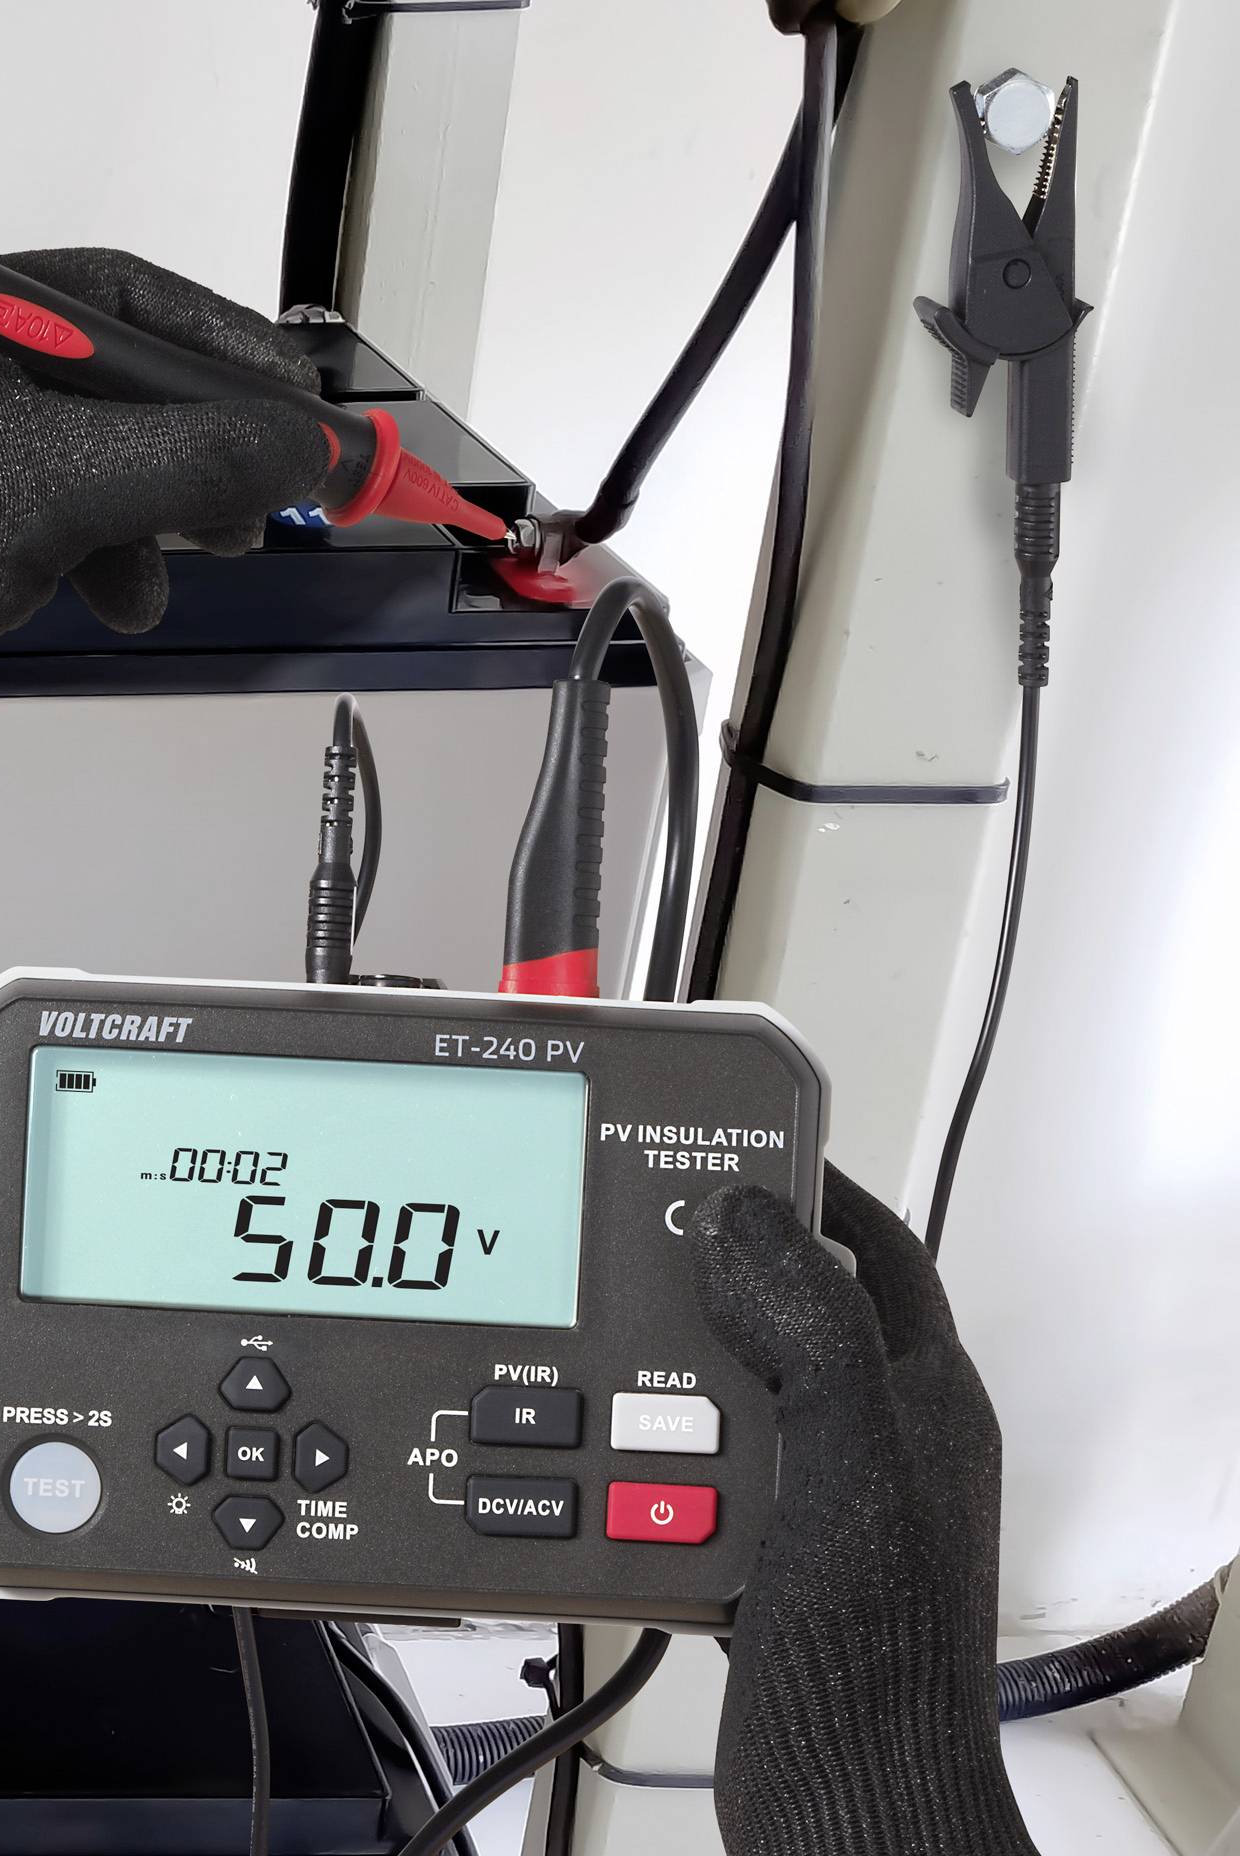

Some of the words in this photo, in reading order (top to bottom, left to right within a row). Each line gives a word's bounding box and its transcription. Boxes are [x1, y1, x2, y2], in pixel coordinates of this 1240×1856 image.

[39, 1010, 193, 1043] VOLTCRAFT
[435, 1034, 536, 1061] ET-240
[546, 1040, 585, 1064] PV
[600, 1123, 632, 1143] PV
[638, 1125, 785, 1149] INSULATION
[169, 1147, 289, 1187] 00:02
[644, 1150, 740, 1172] TESTER
[231, 1195, 461, 1291] 50.0
[477, 1229, 501, 1256] V
[494, 1364, 559, 1387] PV(IR)
[637, 1370, 697, 1389] READ
[2, 1406, 69, 1426] PRESS
[87, 1410, 113, 1427] 2S
[514, 1407, 537, 1425] IR
[637, 1414, 695, 1433] SAVE
[237, 1446, 265, 1462] OK
[407, 1447, 458, 1468] APO
[23, 1477, 87, 1498] TEST
[296, 1499, 348, 1518] TIME
[478, 1497, 564, 1517] DCV/ACV
[296, 1521, 359, 1541] COMP
